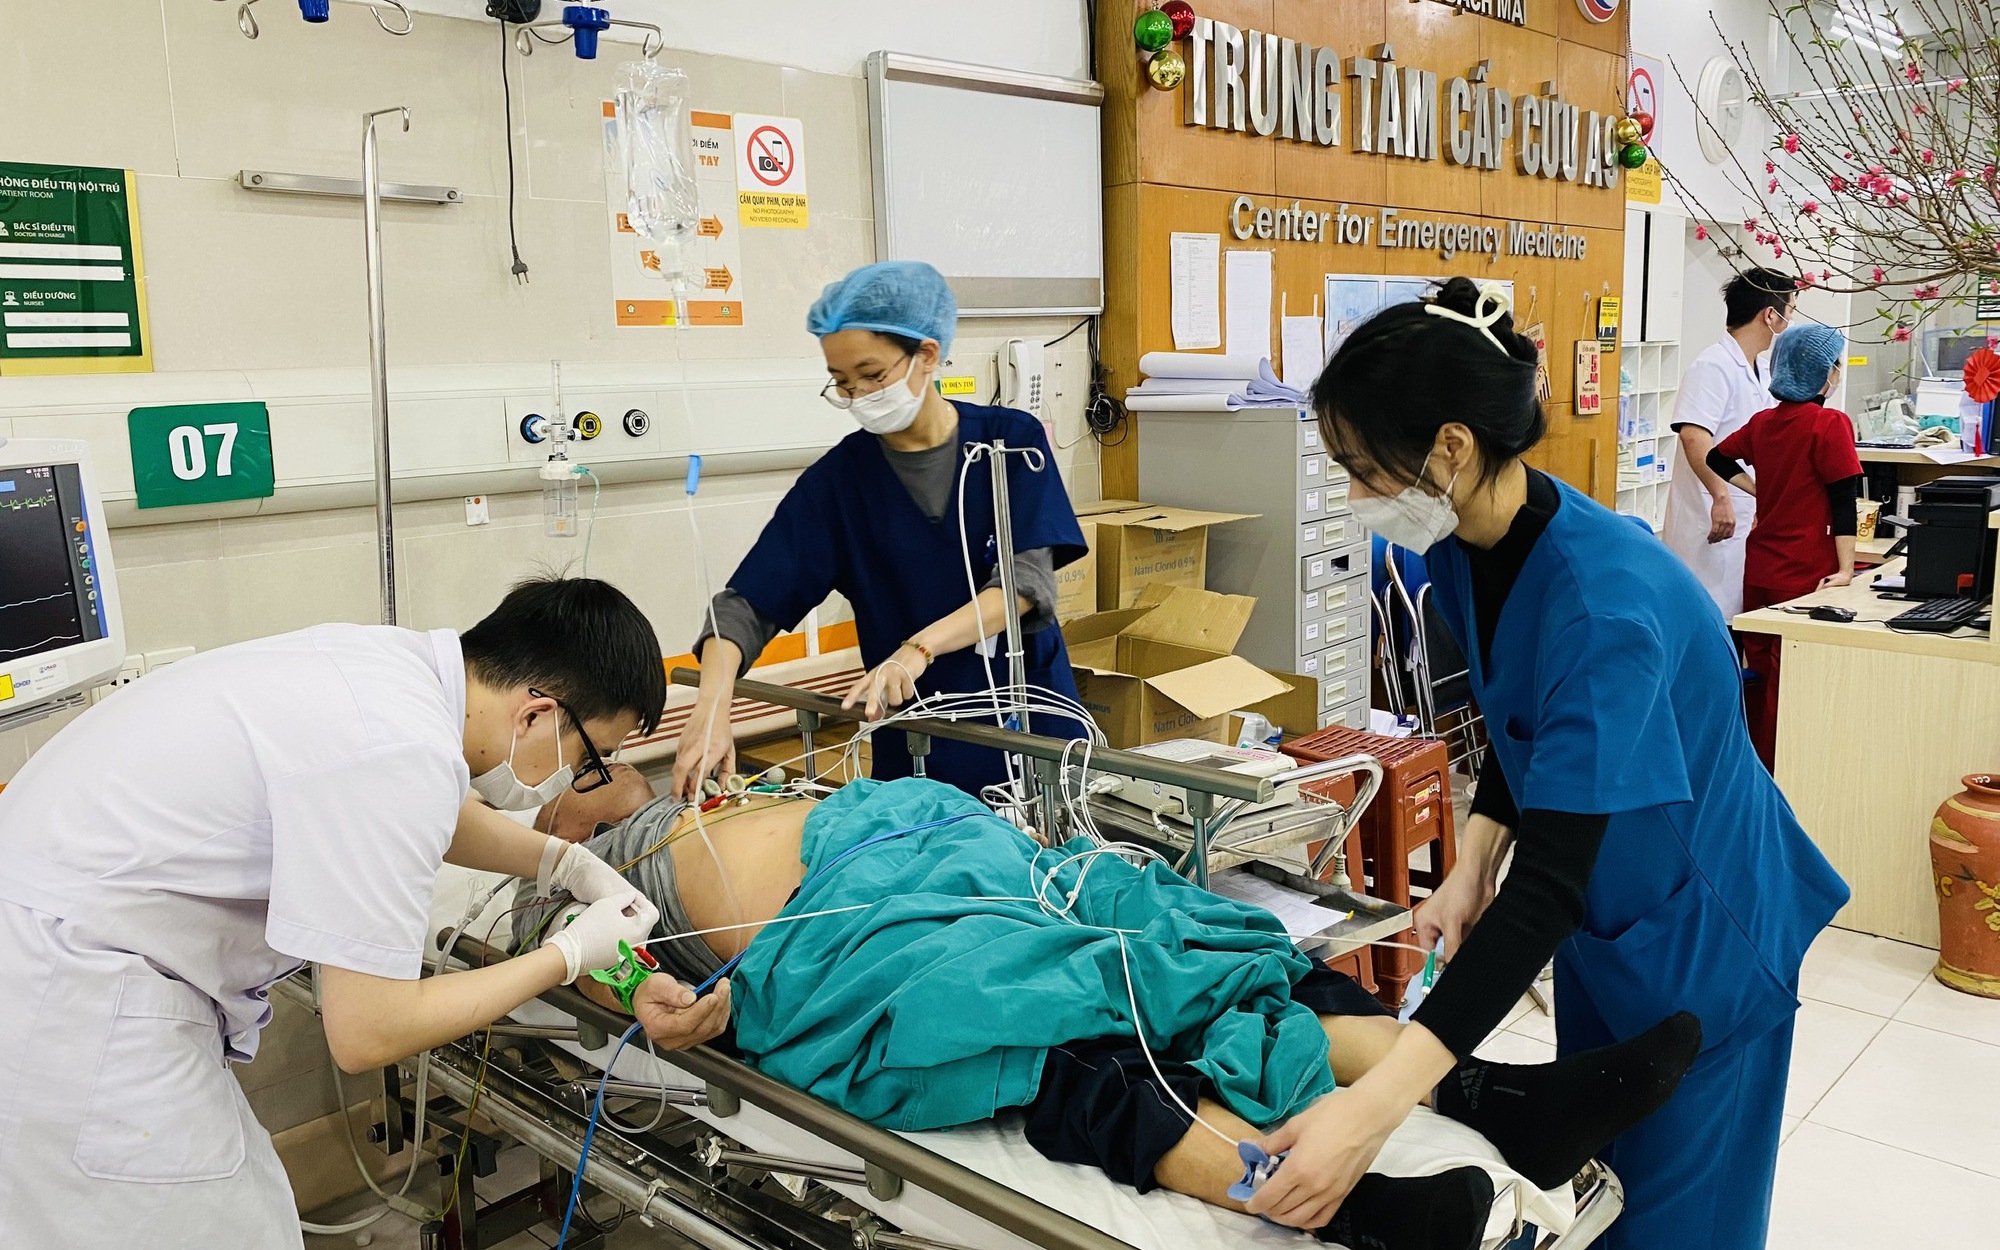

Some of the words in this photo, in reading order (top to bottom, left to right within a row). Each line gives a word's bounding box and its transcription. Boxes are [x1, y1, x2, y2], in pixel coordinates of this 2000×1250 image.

[1184, 17, 1341, 147] TRUNG
[1346, 42, 1437, 161] TÂM
[1443, 58, 1513, 170] CẤP
[1515, 80, 1580, 182] CỨU
[698, 154, 718, 166] TAY
[30, 178, 57, 189] ĐIỀU
[58, 181, 76, 192] TRỊ
[78, 181, 97, 192] NỘI
[99, 182, 119, 192] TRÚ
[29, 191, 53, 199] ROOM
[13, 222, 31, 230] BÁC
[40, 223, 61, 231] ĐIỀU
[1229, 195, 1331, 243] Center
[1332, 203, 1375, 245] for
[1377, 207, 1505, 263] Emergency
[1505, 219, 1587, 261] Medicine
[23, 291, 43, 299] ĐIỀU
[44, 291, 76, 299] DƯỠNG
[168, 422, 238, 481] 07
[1134, 565, 1154, 576] Natri
[1154, 560, 1177, 573] Clorid
[1177, 556, 1196, 569] 0,9%
[1064, 569, 1086, 583] 0,9%
[1153, 720, 1176, 733] Natri
[1470, 1064, 1490, 1110] adidas
